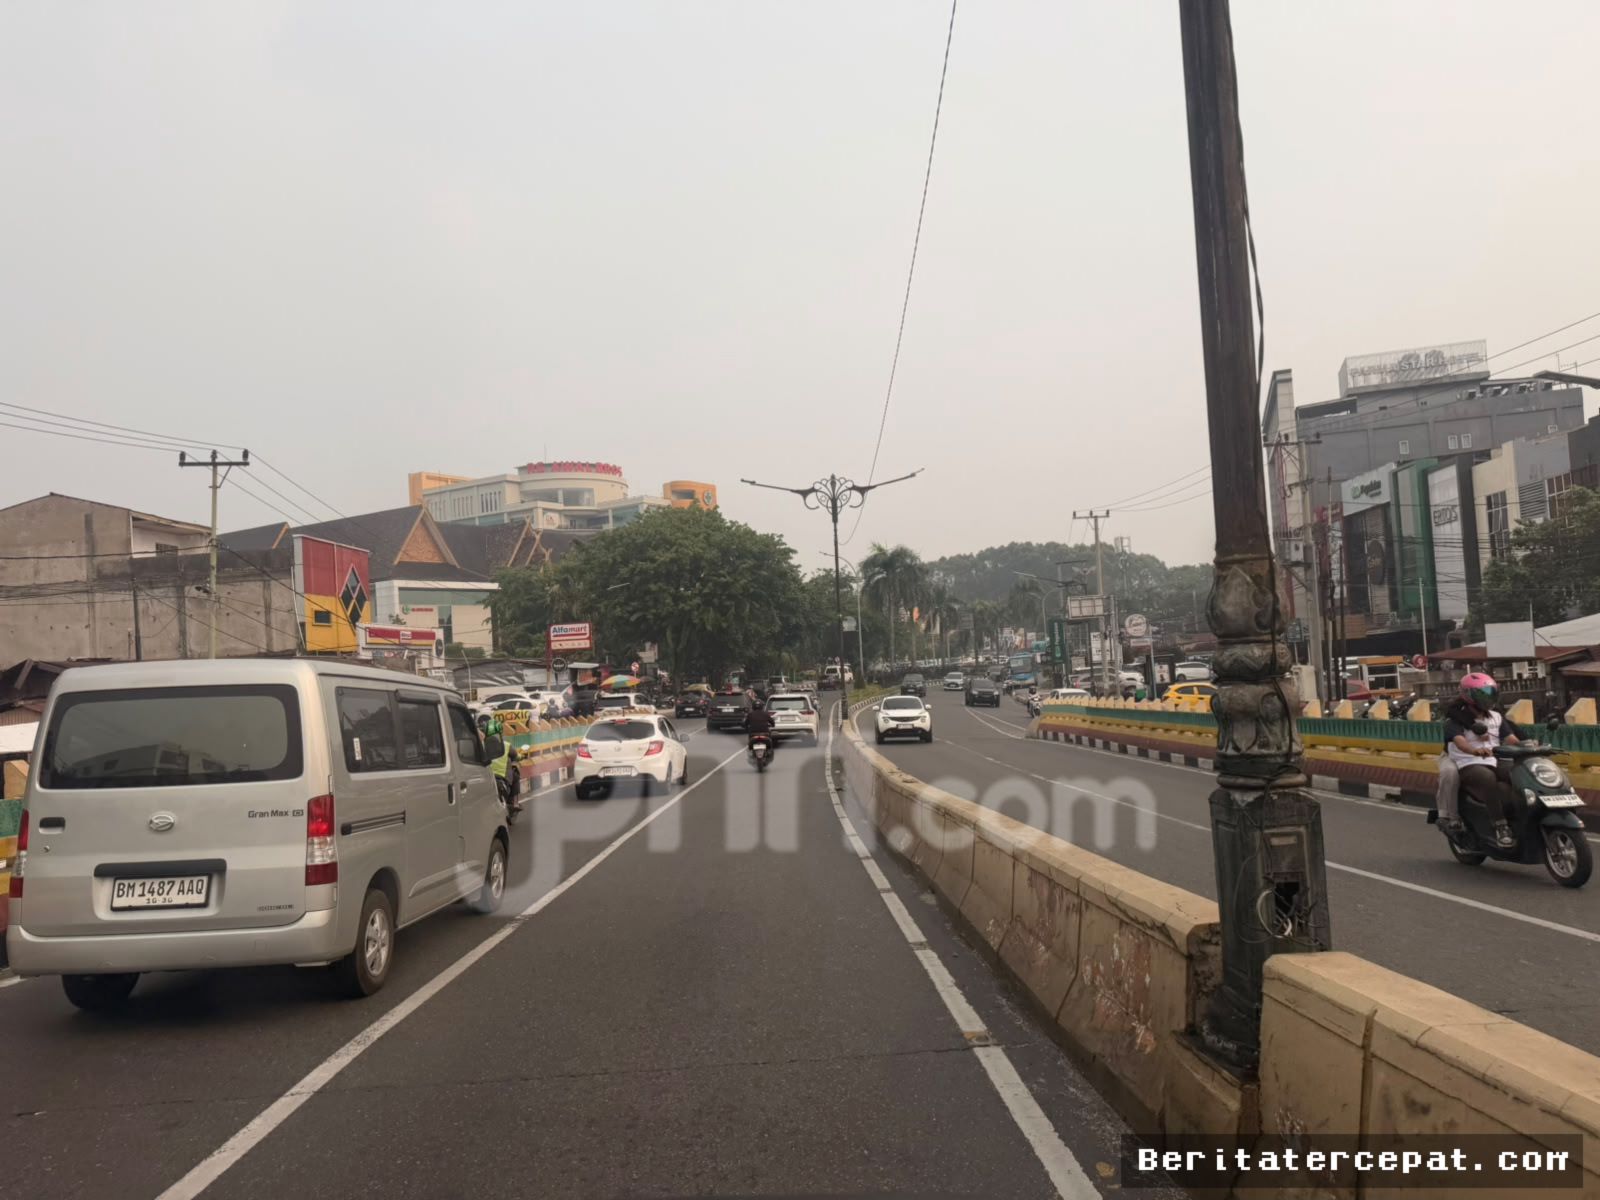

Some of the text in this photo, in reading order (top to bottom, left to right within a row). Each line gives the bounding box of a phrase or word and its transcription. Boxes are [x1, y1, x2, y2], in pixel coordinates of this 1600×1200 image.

[552, 626, 587, 634] Alfamart
[248, 810, 269, 818] Gran
[271, 809, 289, 817] Max
[116, 879, 204, 898] BM 1487 AAQ
